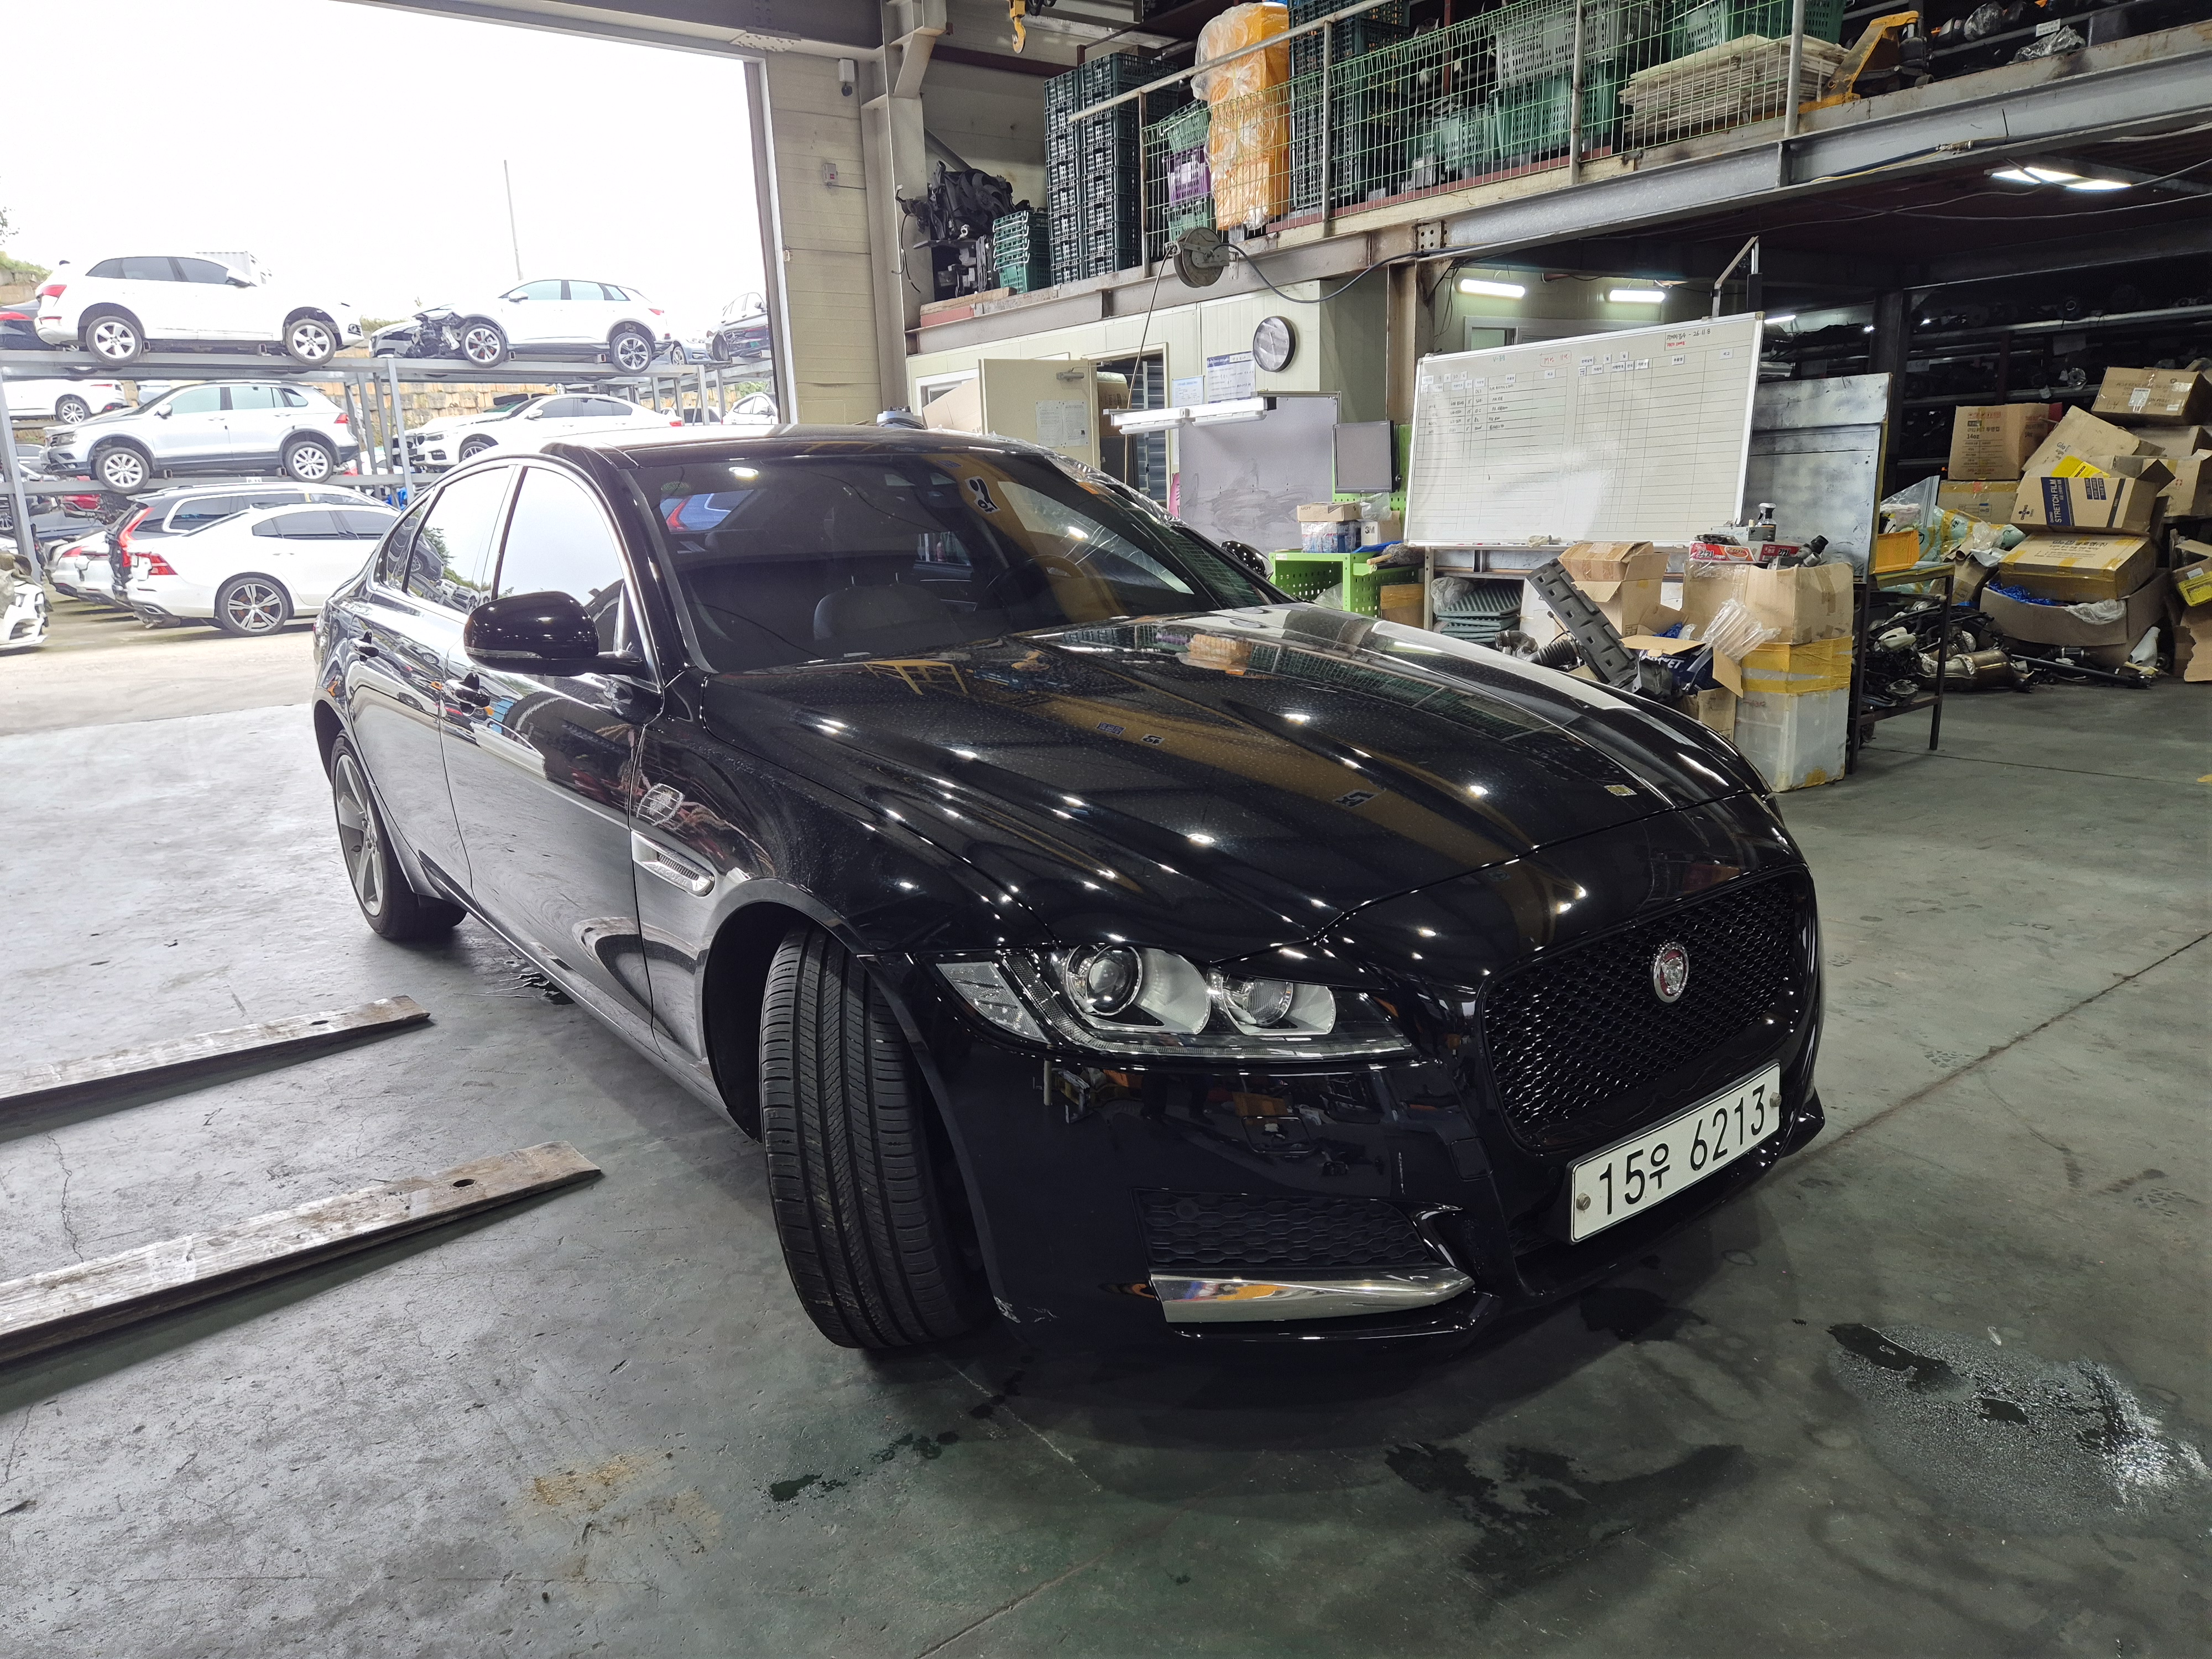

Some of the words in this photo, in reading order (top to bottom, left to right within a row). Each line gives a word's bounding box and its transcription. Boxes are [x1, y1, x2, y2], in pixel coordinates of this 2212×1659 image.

[2049, 479, 2058, 494] FILM
[2052, 494, 2062, 523] STRETCH
[1365, 526, 1375, 534] 3M
[654, 865, 688, 886] JAGUAR
[1599, 1143, 1670, 1215] 15우
[1690, 1084, 1765, 1171] 6213
